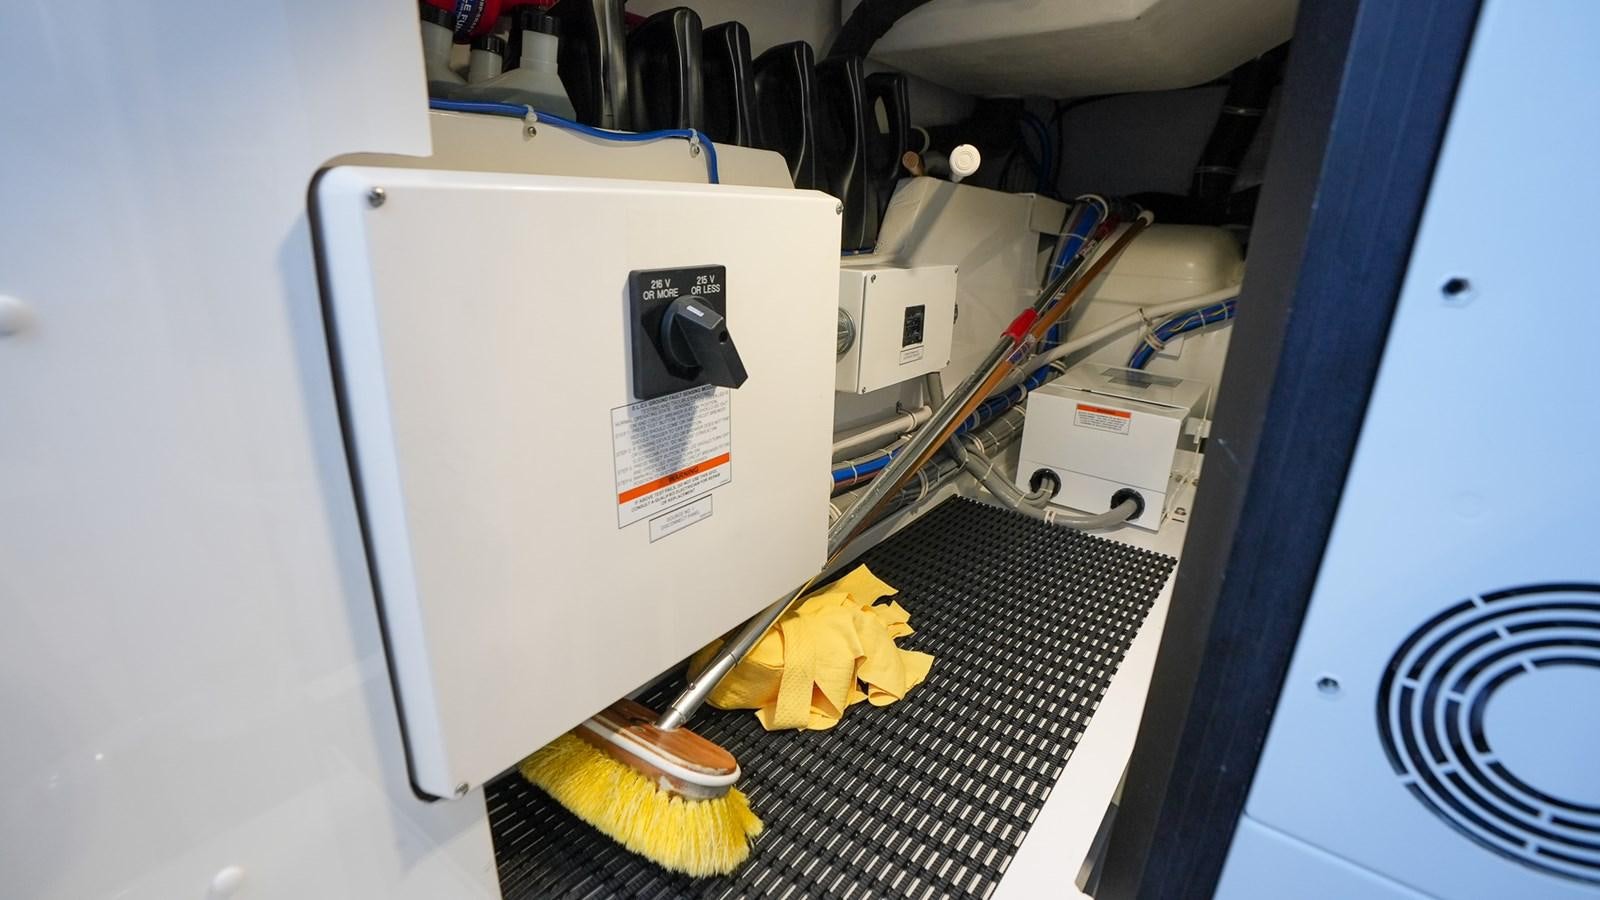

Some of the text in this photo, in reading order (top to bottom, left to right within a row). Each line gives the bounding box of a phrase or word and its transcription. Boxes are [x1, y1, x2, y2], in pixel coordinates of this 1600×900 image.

[650, 278, 671, 289] 216 V
[696, 274, 715, 285] 215 V
[643, 288, 679, 300] OR MORE
[691, 284, 721, 295] OR LESS
[669, 392, 681, 400] FAULT
[683, 387, 700, 397] SENSING
